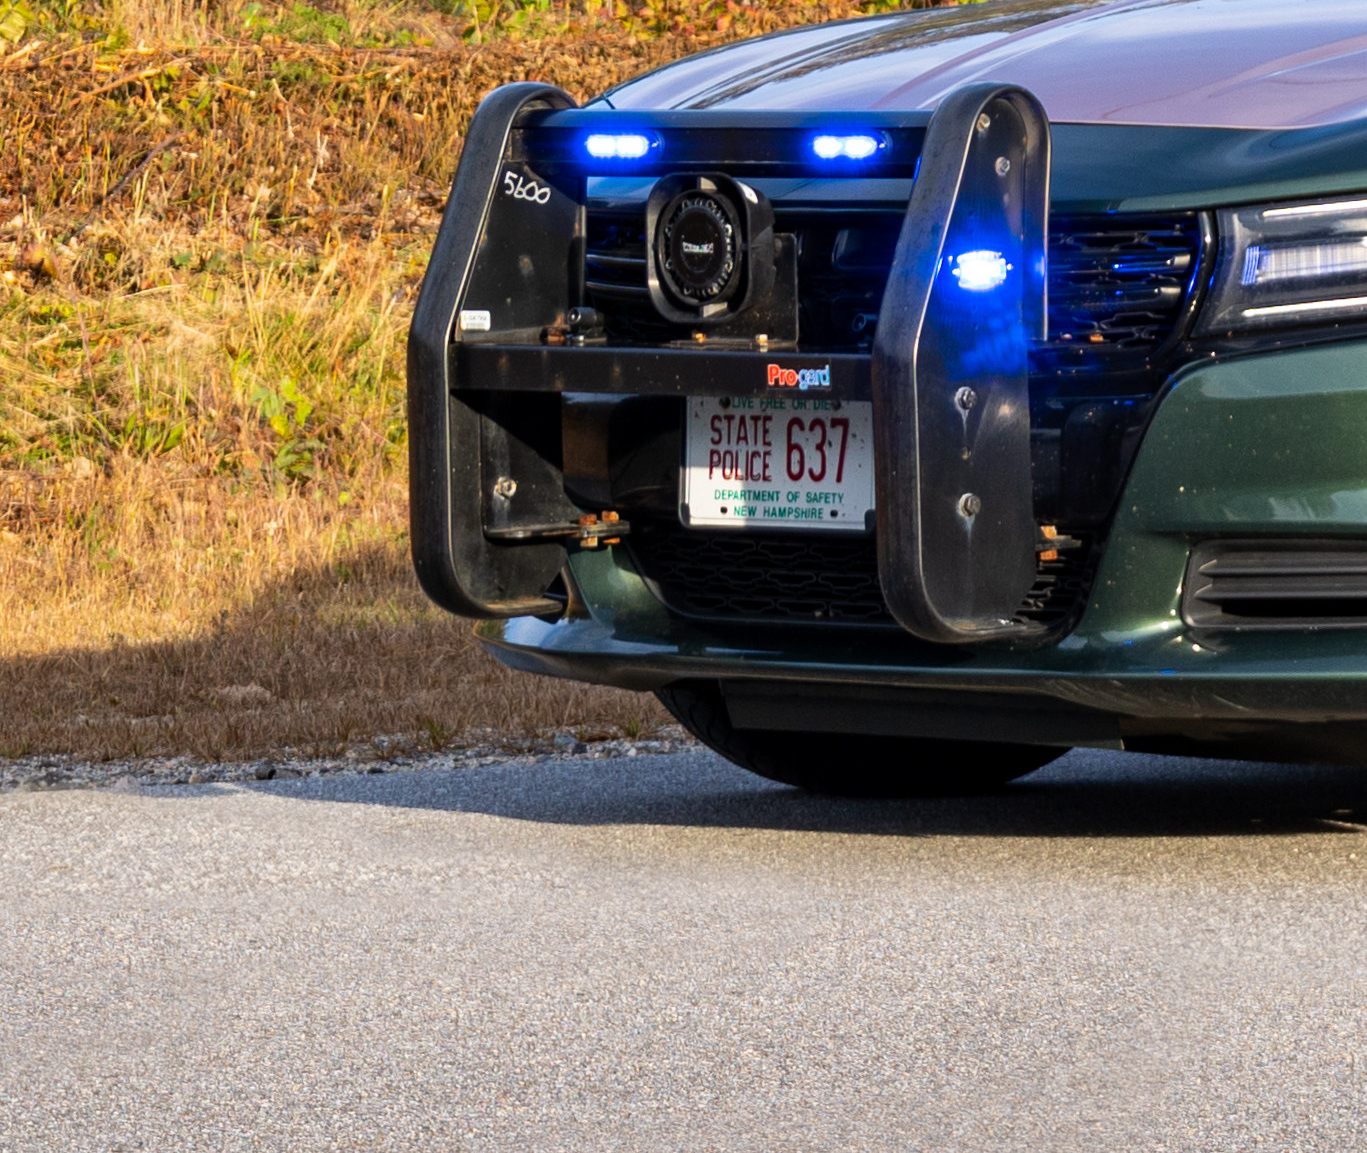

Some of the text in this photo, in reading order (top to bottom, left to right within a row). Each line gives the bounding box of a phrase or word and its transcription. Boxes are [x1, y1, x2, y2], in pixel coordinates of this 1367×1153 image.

[504, 171, 551, 204] 5600
[731, 398, 831, 410] LIVE FREE OR DIE
[710, 415, 773, 446] STATE
[709, 449, 772, 481] POLICE
[786, 417, 849, 483] 637
[714, 489, 844, 504] DEPARTMENT OF SAFETY
[734, 506, 824, 519] NEW HAMPSHIRE
